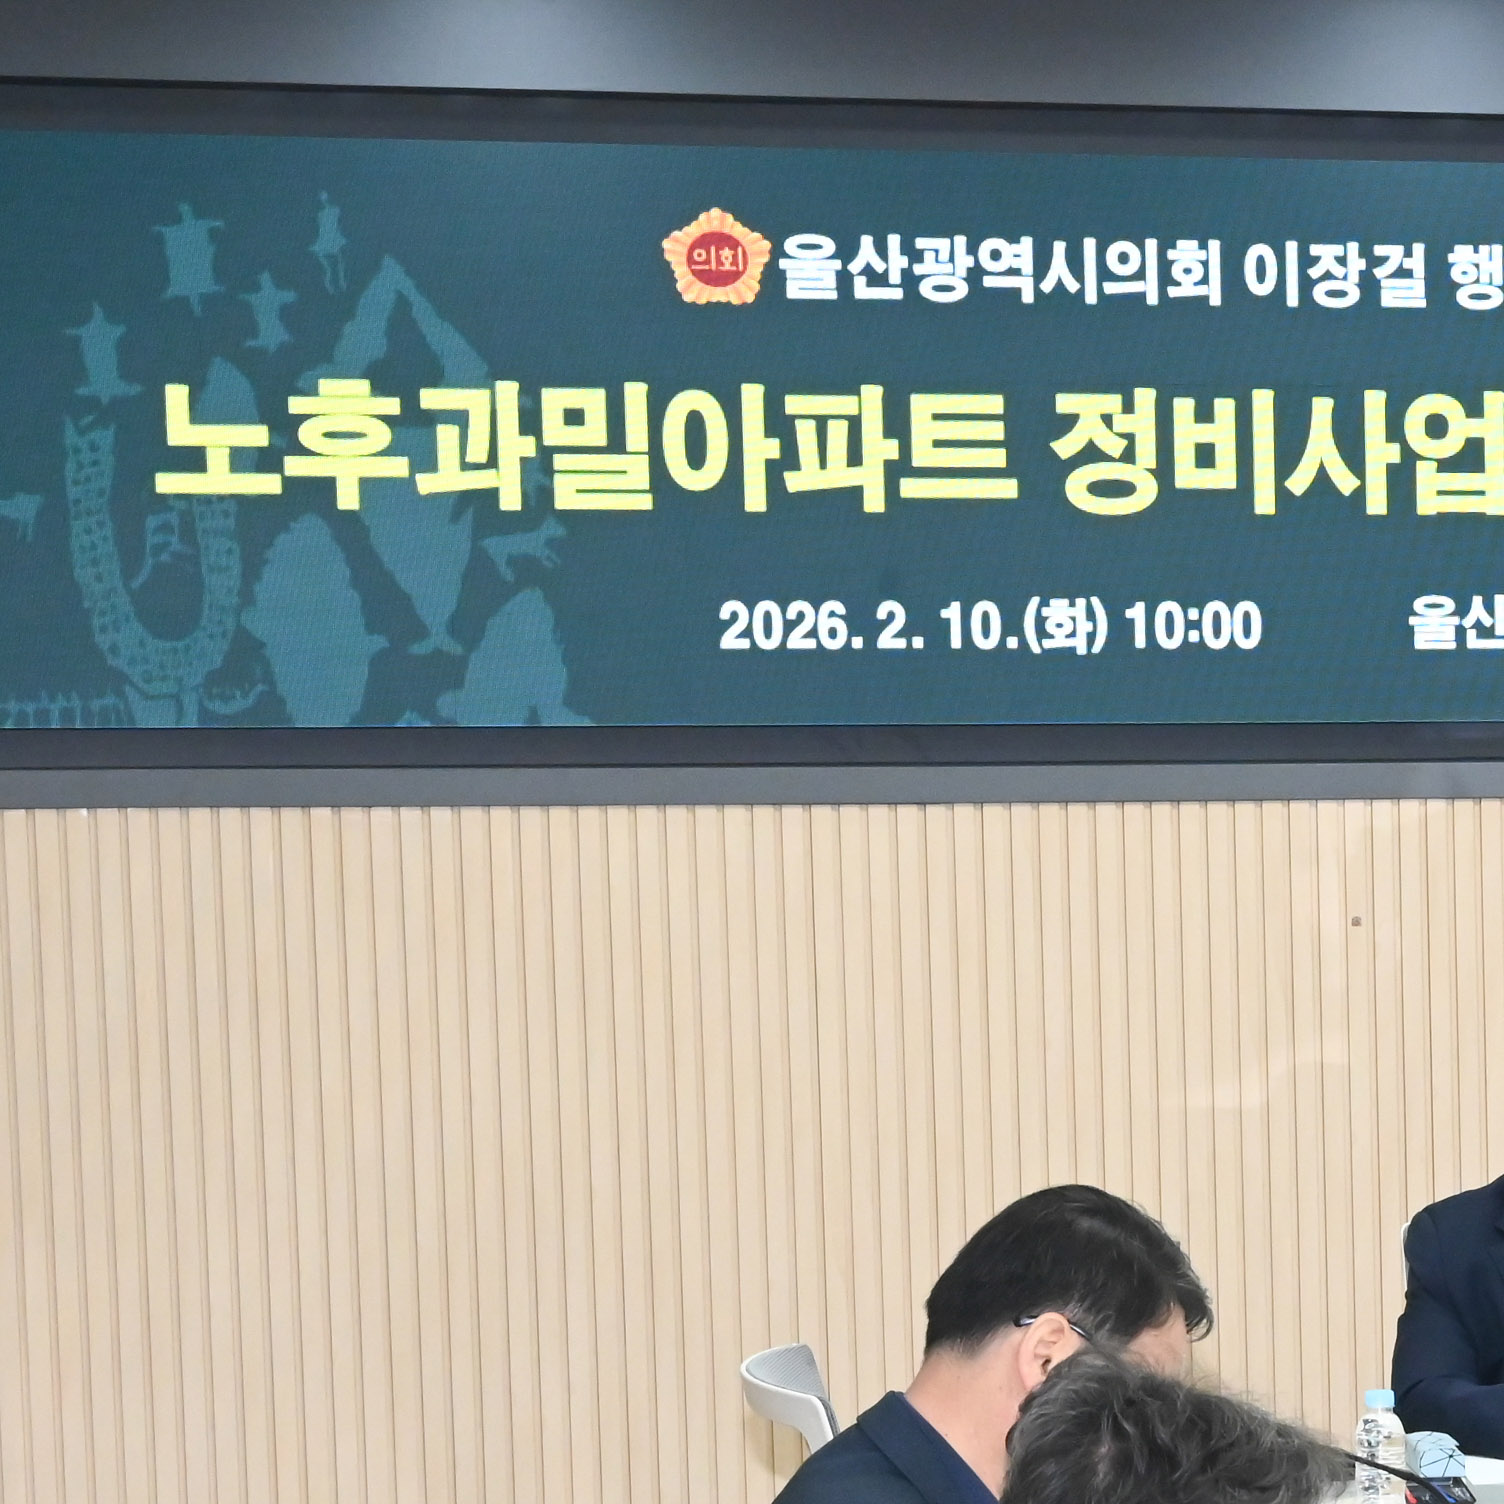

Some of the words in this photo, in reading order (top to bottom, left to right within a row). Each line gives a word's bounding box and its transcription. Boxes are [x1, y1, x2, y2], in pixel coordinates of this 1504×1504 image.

[690, 244, 744, 272] 의회
[778, 233, 1222, 307] 울산광역시의회
[1243, 240, 1427, 309] 이장걸
[154, 378, 1019, 513] 노후과밀아파트
[719, 599, 864, 650] 2026.
[876, 599, 924, 649] 2.
[940, 596, 1108, 656] 10.(화)
[1125, 599, 1262, 650] 10:00
